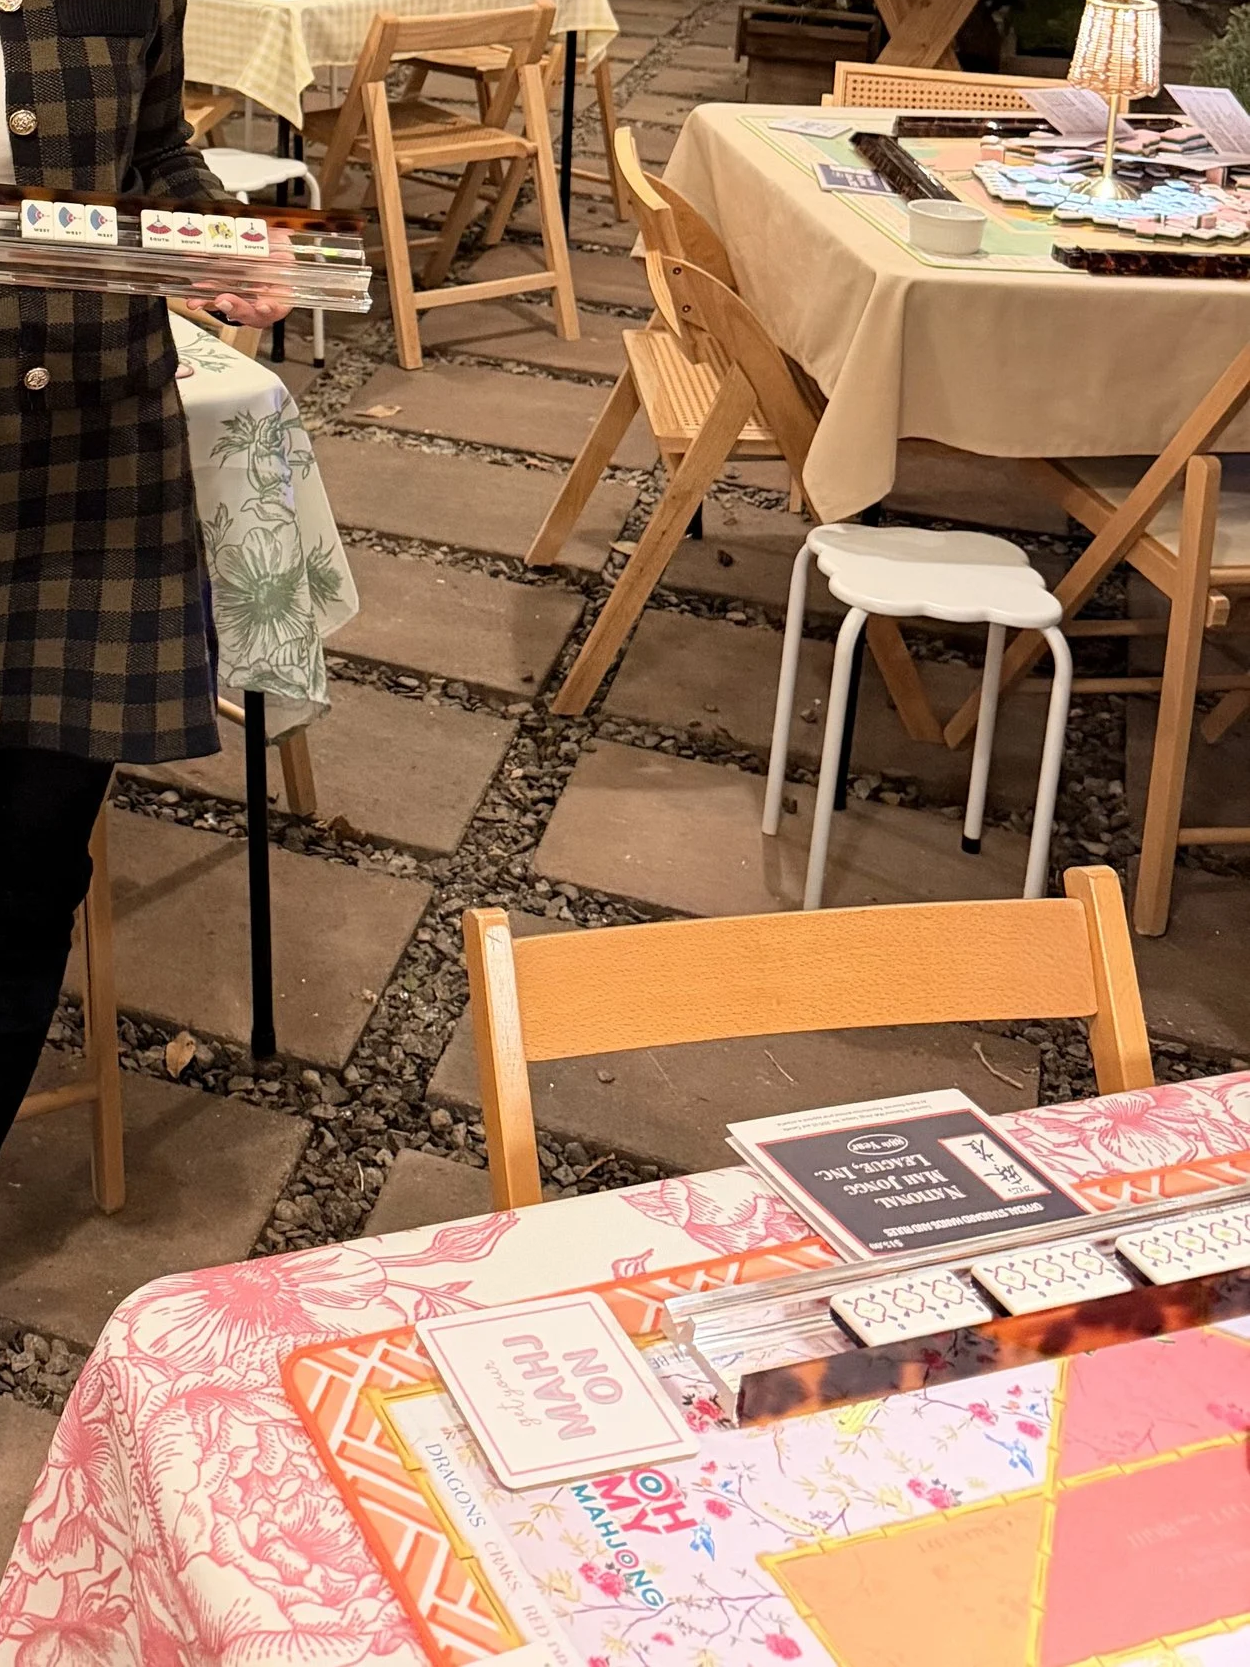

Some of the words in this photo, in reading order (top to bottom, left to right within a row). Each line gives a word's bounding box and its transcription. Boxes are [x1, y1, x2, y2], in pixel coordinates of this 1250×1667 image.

[850, 1140, 881, 1153] Year
[813, 1163, 852, 1182] INC.
[851, 1153, 932, 1173] LEAGUE,
[842, 1173, 901, 1197] JONGG
[904, 1168, 950, 1187] MAH
[873, 1184, 967, 1210] NATIONAL
[1007, 1201, 1045, 1217] OFFICIAL
[912, 1219, 933, 1232] AND
[934, 1214, 962, 1228] HANDS
[962, 1207, 1007, 1224] STANDARD
[883, 1222, 912, 1237] RULES
[483, 1357, 526, 1400] your
[502, 1334, 597, 1441] MAHJ
[562, 1347, 623, 1405] ON
[497, 1400, 543, 1428] get
[592, 1475, 664, 1534] MY
[629, 1467, 699, 1535] OH
[424, 1442, 487, 1529] DRAGONS
[483, 1540, 523, 1592] CRAKS
[521, 1604, 552, 1639] RED
[570, 1483, 665, 1608] MAHJONG
